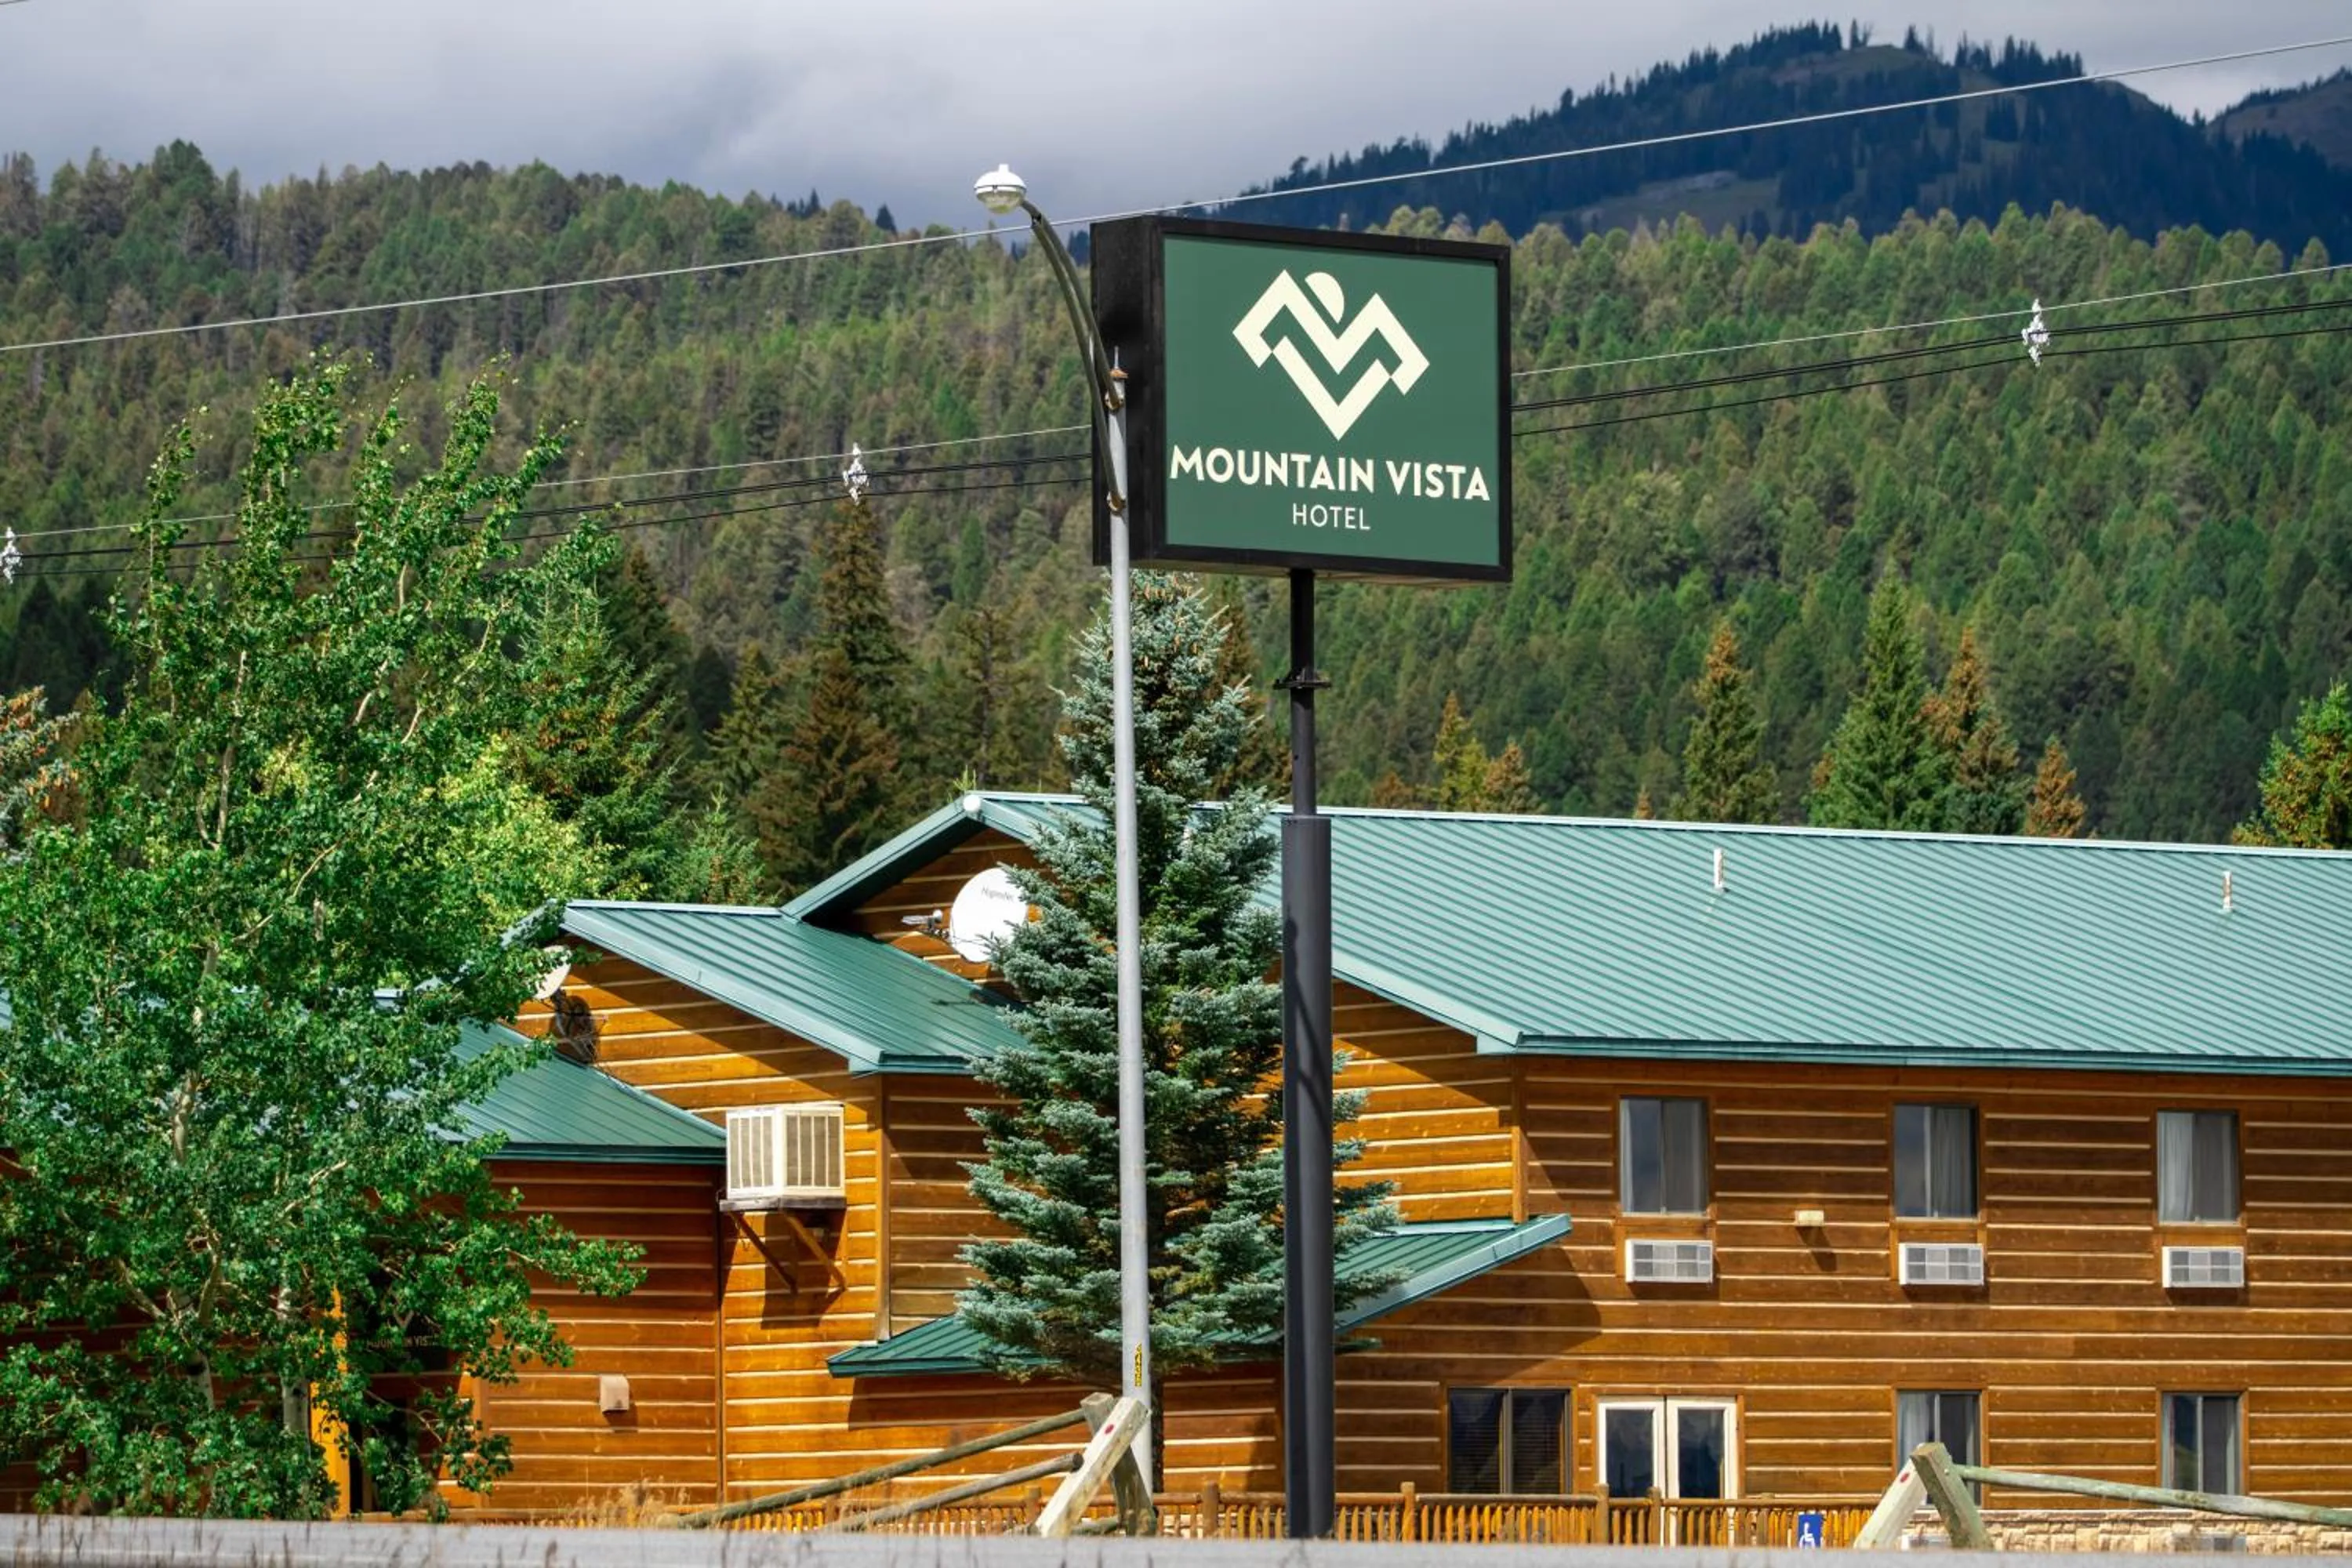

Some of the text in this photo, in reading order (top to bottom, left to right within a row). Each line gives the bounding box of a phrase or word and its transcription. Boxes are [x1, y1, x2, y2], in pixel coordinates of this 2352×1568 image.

[1170, 445, 1490, 501] MOUNTAIN VISTA
[1293, 503, 1371, 530] HOTEL
